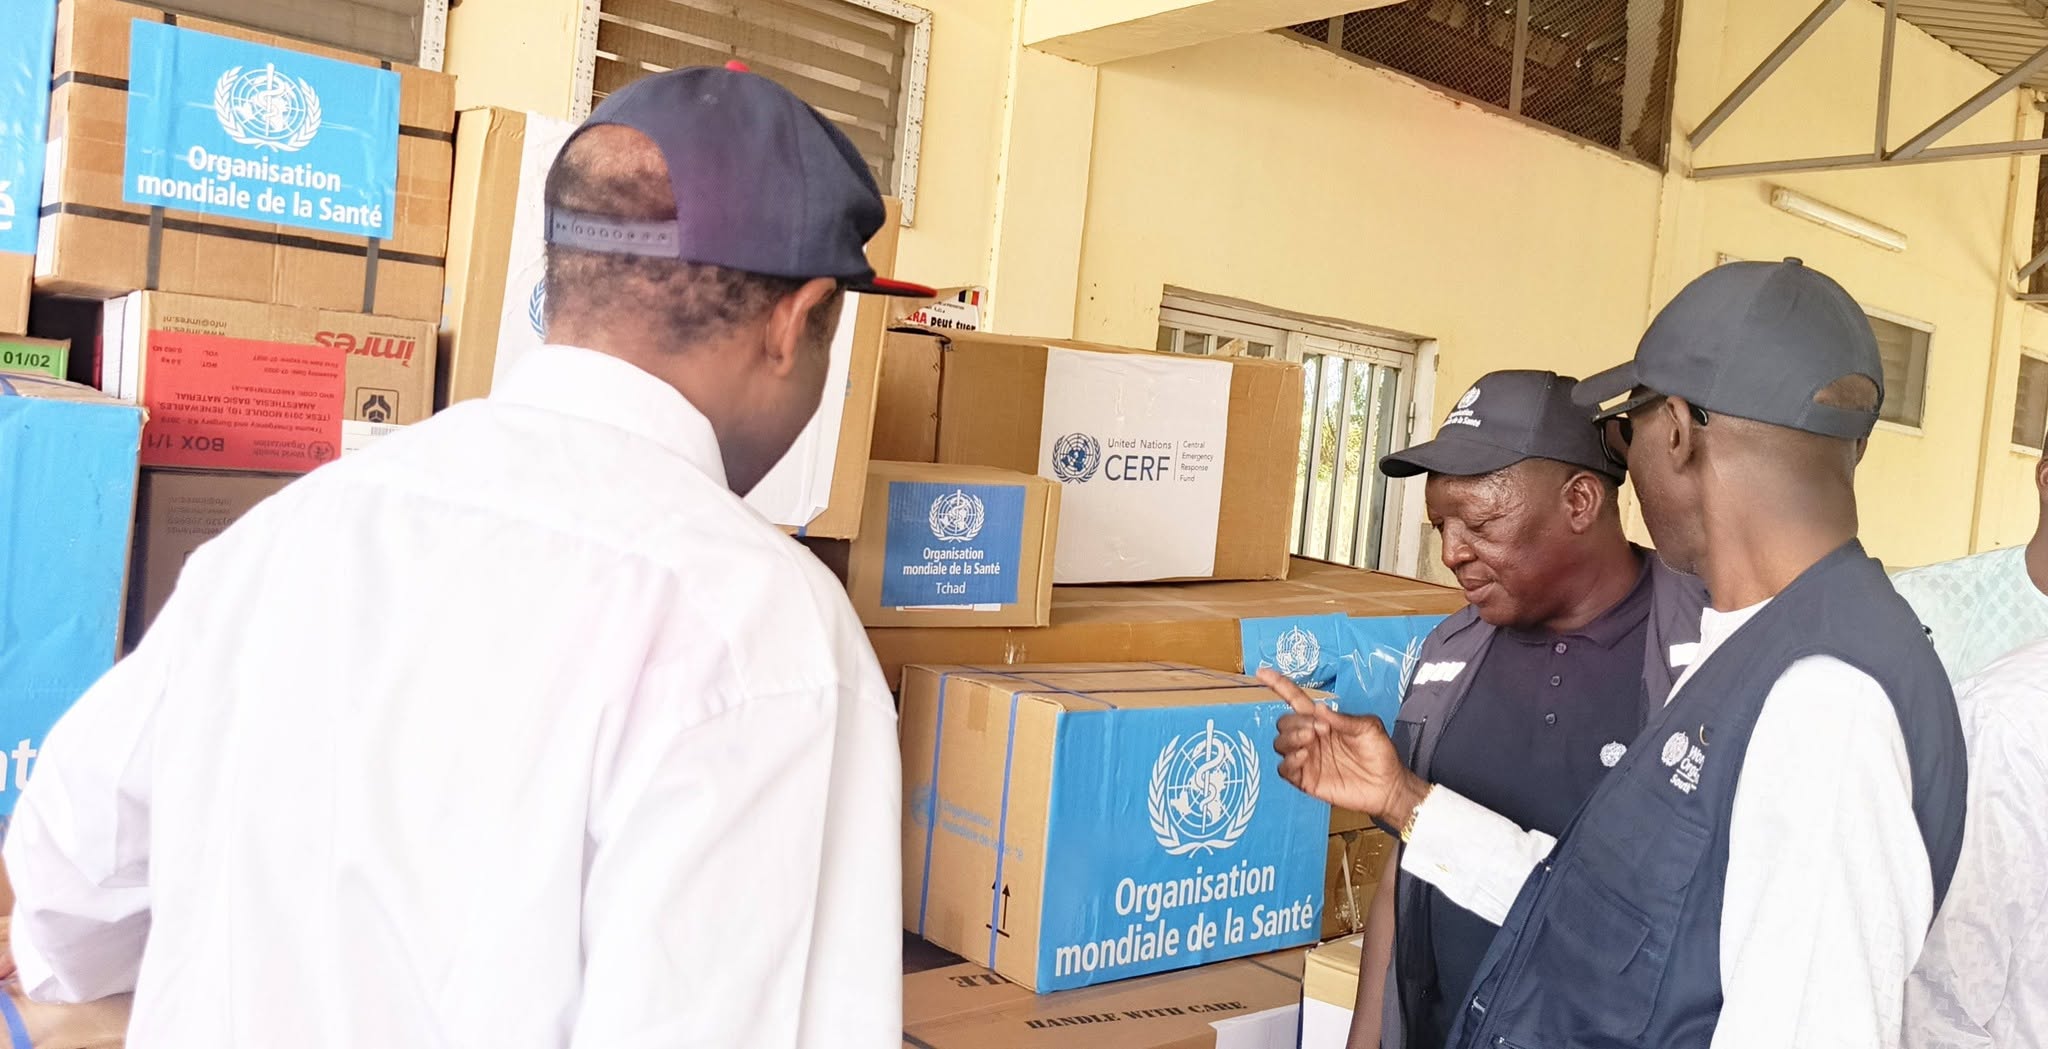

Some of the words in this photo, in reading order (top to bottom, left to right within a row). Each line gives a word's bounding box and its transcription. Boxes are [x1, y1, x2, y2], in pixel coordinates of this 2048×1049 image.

[187, 145, 341, 192] Organisation
[137, 174, 250, 209] mondiale
[257, 187, 285, 215] de
[293, 191, 312, 218] la
[319, 197, 382, 228] Santé
[162, 315, 227, 328] info@imres.nl
[931, 317, 953, 328] peut
[314, 331, 415, 368] imres
[4, 351, 50, 368] 01/02
[175, 392, 221, 404] MATERIAL
[223, 396, 250, 407] BASIC
[245, 408, 282, 418] MODULE
[250, 421, 293, 432] Emergency
[148, 433, 171, 449] 1/1
[182, 435, 225, 452] BOX
[253, 440, 306, 450] Organization
[1107, 438, 1136, 449] United
[1140, 439, 1172, 450] Nations
[1182, 440, 1205, 449] Central
[1182, 452, 1214, 463] Emergency
[1104, 454, 1170, 481] CERF
[1180, 463, 1208, 473] Response
[1179, 474, 1195, 482] Fund
[923, 547, 984, 563] Organisation
[903, 562, 947, 575] mondiale
[949, 562, 961, 575] de
[963, 562, 972, 575] la
[973, 562, 1000, 575] Santé
[935, 582, 966, 594] Tchad
[1115, 859, 1275, 922] Organisation
[1055, 919, 1179, 977] mondiale
[1186, 912, 1217, 953] de
[1223, 907, 1245, 945] la
[1251, 895, 1313, 941] Santé
[1024, 1012, 1121, 1030] HANDLE
[1122, 1005, 1185, 1022] WITH
